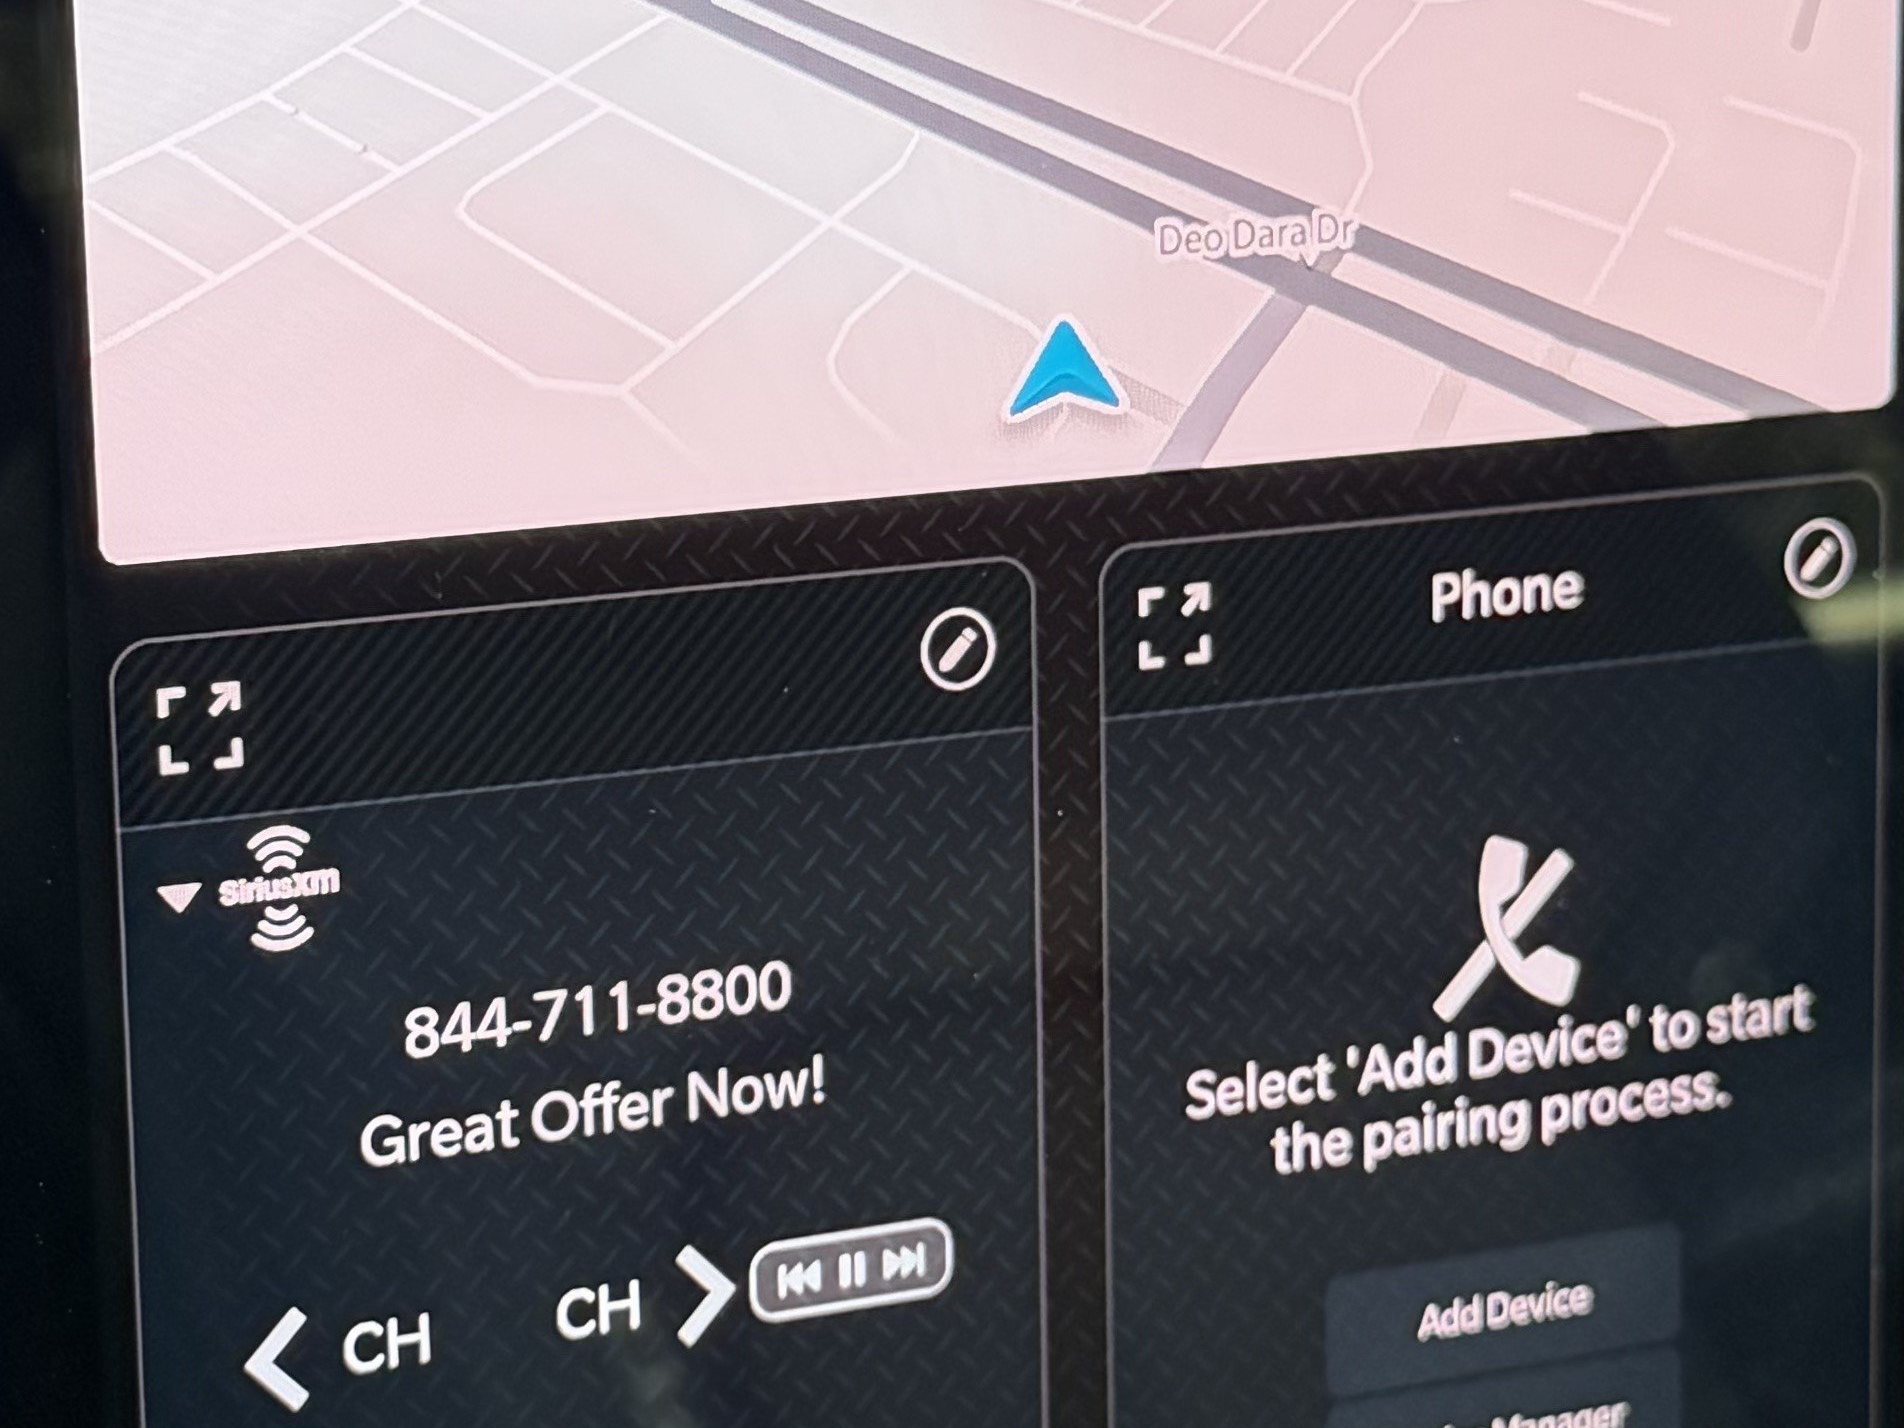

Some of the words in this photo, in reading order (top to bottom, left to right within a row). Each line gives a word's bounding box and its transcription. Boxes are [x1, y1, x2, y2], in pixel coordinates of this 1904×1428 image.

[1157, 222, 1225, 256] Deo
[1231, 217, 1306, 252] Dara
[1314, 215, 1354, 247] Dr
[1430, 569, 1585, 624] Phone
[403, 960, 792, 1061] 844-711-8800
[1184, 1052, 1335, 1122] Select
[1346, 1027, 1459, 1096] 'Add
[1467, 1004, 1640, 1079] Device'
[1649, 1004, 1697, 1050] to
[1705, 983, 1813, 1044] start
[359, 1099, 521, 1170] Great
[529, 1081, 674, 1145] Offer
[687, 1052, 828, 1121] Now!
[1270, 1122, 1352, 1174] the
[1362, 1086, 1529, 1173] pairing
[1540, 1066, 1733, 1144] process.
[554, 1279, 642, 1341] CH
[1416, 1293, 1481, 1342] Add
[1486, 1279, 1594, 1332] Device
[341, 1312, 432, 1376] CH
